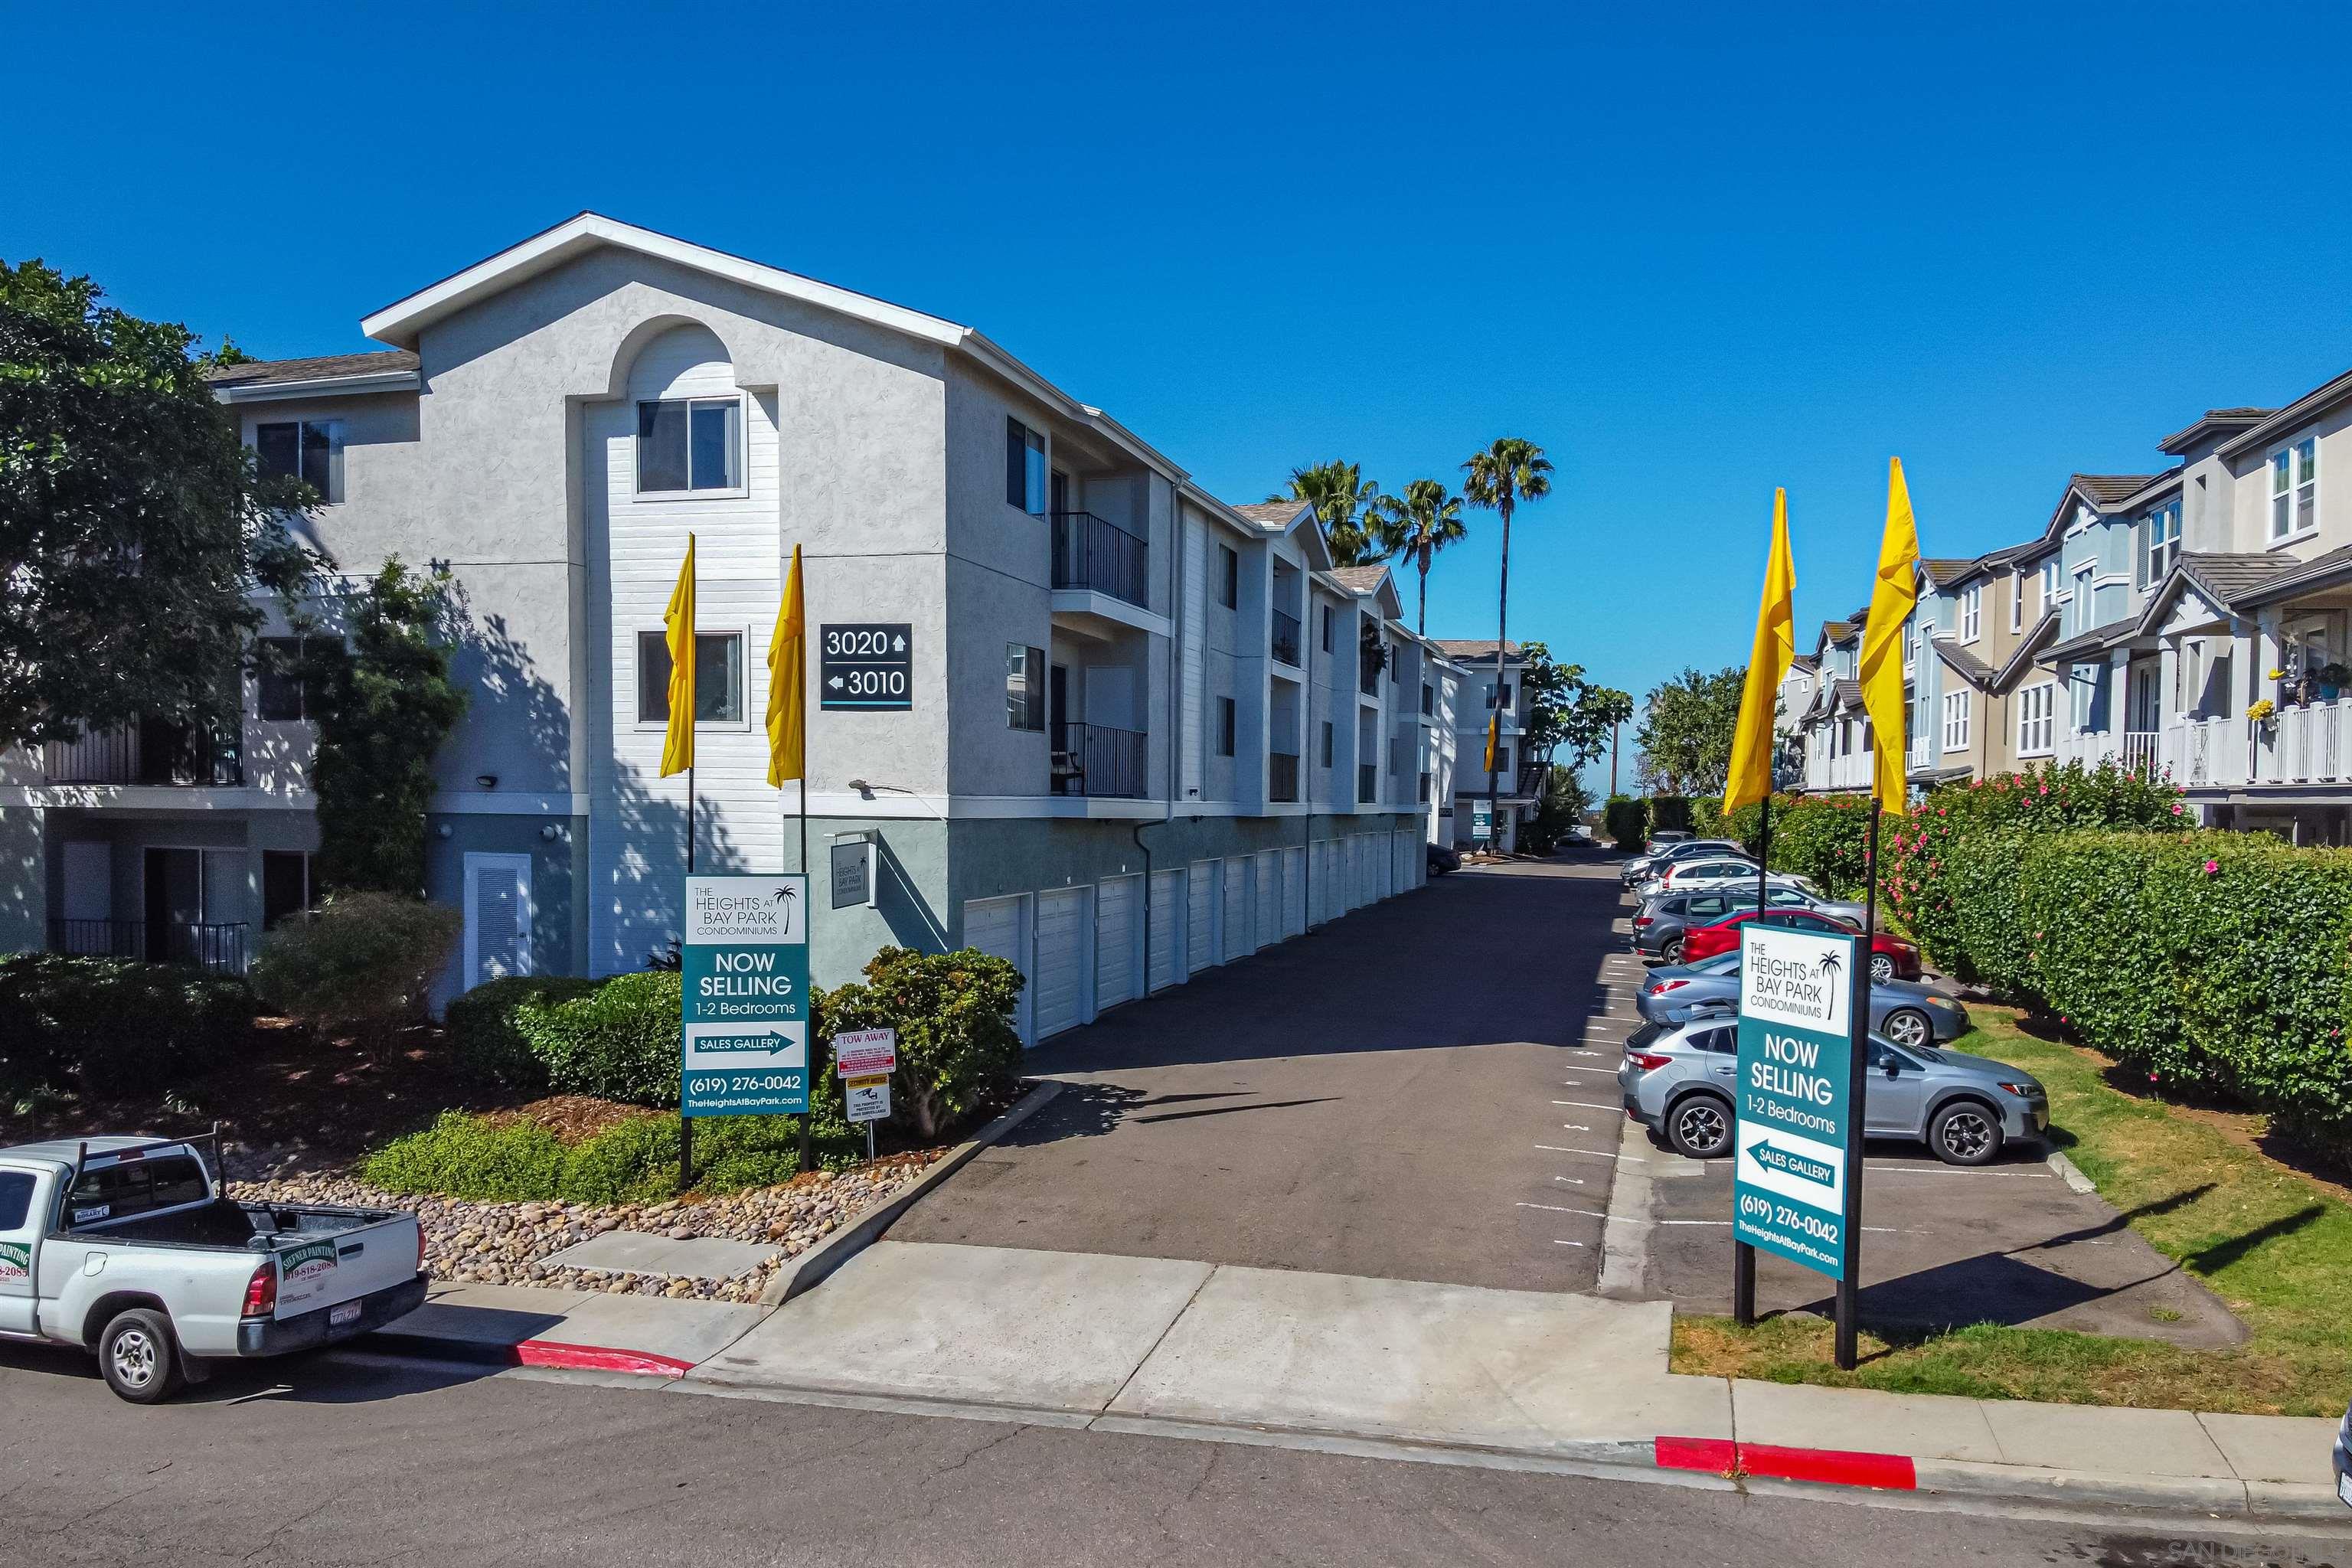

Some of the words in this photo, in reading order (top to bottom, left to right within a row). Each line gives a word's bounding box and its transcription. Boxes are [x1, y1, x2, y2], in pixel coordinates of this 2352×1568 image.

[827, 631, 887, 655] 3020
[848, 671, 905, 694] 3010
[694, 887, 713, 897] THE
[696, 897, 760, 910] HEIGHTS
[704, 911, 733, 924] BAY
[737, 911, 778, 924] PARK
[697, 926, 778, 936] CONDOMINIUMS
[1750, 942, 1766, 956] THE
[716, 952, 776, 972] NOW
[1751, 956, 1807, 981] HEIGHTS
[1809, 969, 1820, 979] AT
[700, 975, 792, 997] SELLING
[1756, 975, 1782, 996] BAY
[1785, 981, 1822, 1004] PARK
[695, 1002, 716, 1016] 1-2
[720, 1002, 796, 1015] Bedrooms
[1750, 995, 1821, 1018] CONDOMINIUMS
[700, 1039, 731, 1050] SALES
[733, 1038, 781, 1049] GALLERY
[841, 1034, 863, 1045] TOW
[864, 1031, 890, 1042] AWAY
[1765, 1033, 1820, 1069] NOW
[690, 1078, 727, 1096] (619)
[732, 1075, 801, 1091] 276-0042
[1751, 1061, 1833, 1106] SELLING
[688, 1097, 802, 1109] TheHeightsAtBayPark.com
[1747, 1094, 1765, 1115] 1-2
[1768, 1099, 1836, 1135] Bedrooms
[1759, 1148, 1787, 1168] SALES
[1788, 1158, 1831, 1182] GALLERY
[1740, 1194, 1773, 1224] (619)
[1775, 1205, 1838, 1245] 276-0042
[307, 1246, 336, 1258] PAINTING
[1738, 1219, 1839, 1267] TheHeightsAtBayPark.com
